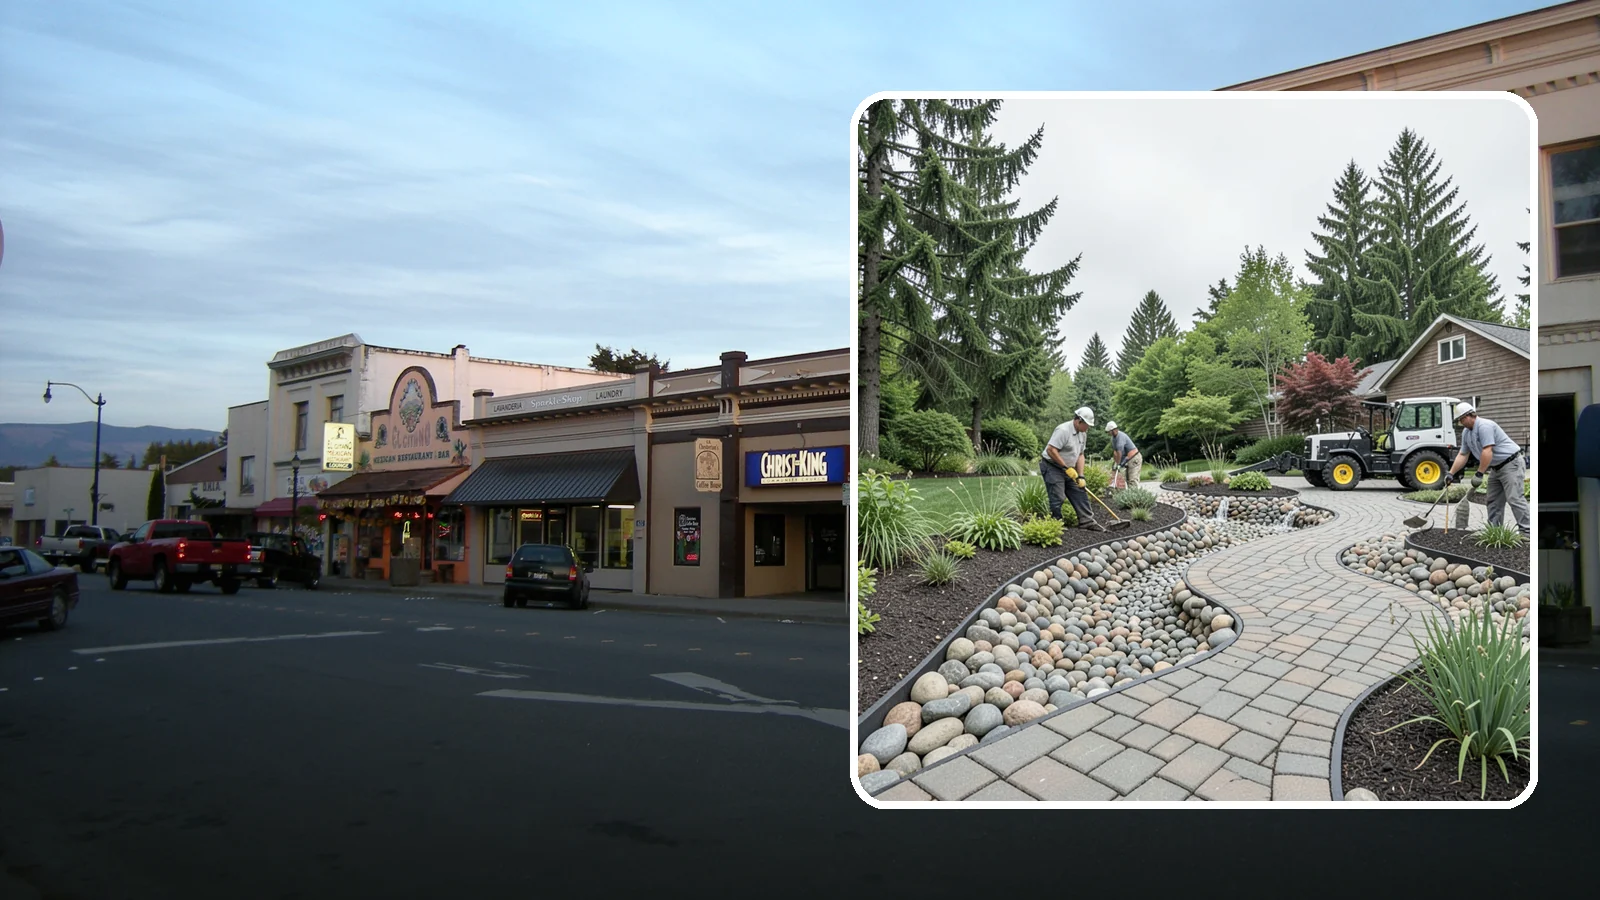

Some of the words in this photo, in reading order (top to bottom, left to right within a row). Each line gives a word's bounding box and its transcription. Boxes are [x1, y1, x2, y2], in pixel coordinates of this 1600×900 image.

[595, 389, 623, 400] LAUNDRY
[493, 402, 522, 412] LAVANDERIA
[530, 398, 560, 409] Sparkle
[561, 394, 583, 406] Shop
[374, 455, 396, 464] MEXICAN
[397, 451, 433, 462] RESTAURANT
[438, 450, 450, 459] BAR
[760, 452, 798, 478] CHRIST
[798, 450, 827, 477] KING
[696, 480, 709, 488] Coffee
